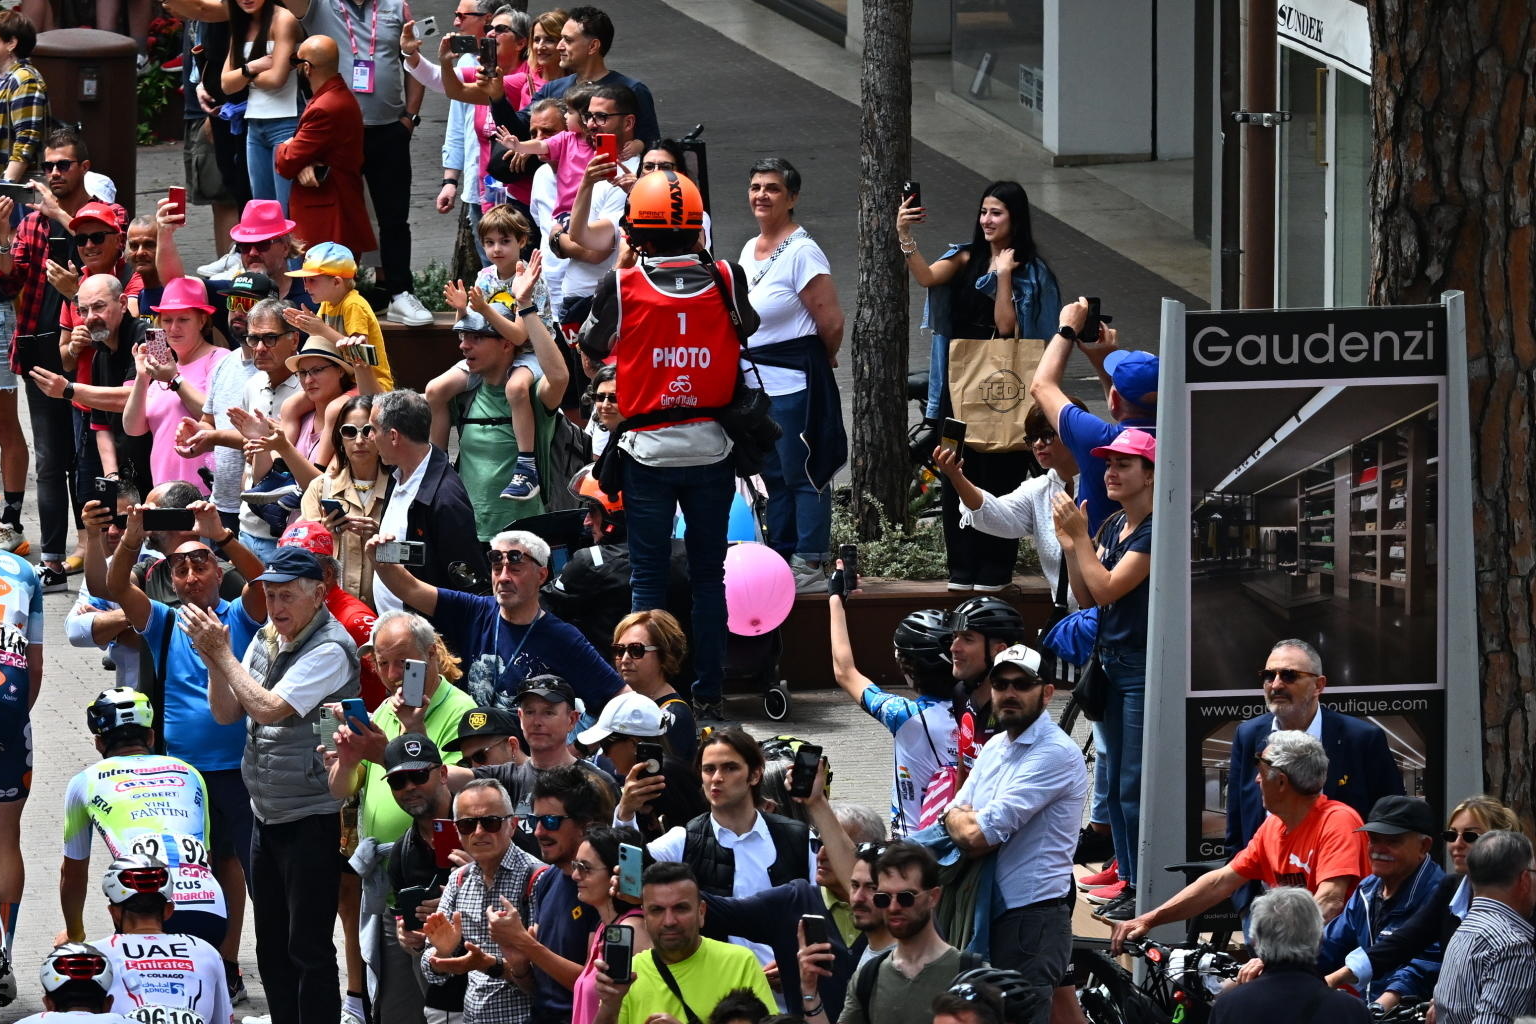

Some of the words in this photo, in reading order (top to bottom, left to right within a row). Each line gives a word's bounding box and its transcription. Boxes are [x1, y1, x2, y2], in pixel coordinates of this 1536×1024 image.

[1278, 3, 1324, 43] SUNDEK
[235, 277, 253, 285] BORA
[678, 313, 686, 334] 1
[1192, 320, 1435, 367] Gaudenzi
[652, 348, 711, 368] PHOTO
[979, 382, 1025, 400] TEDi
[467, 716, 484, 725] 105
[131, 808, 189, 820] FANTINI
[184, 838, 208, 867] 92
[124, 943, 189, 958] UAE
